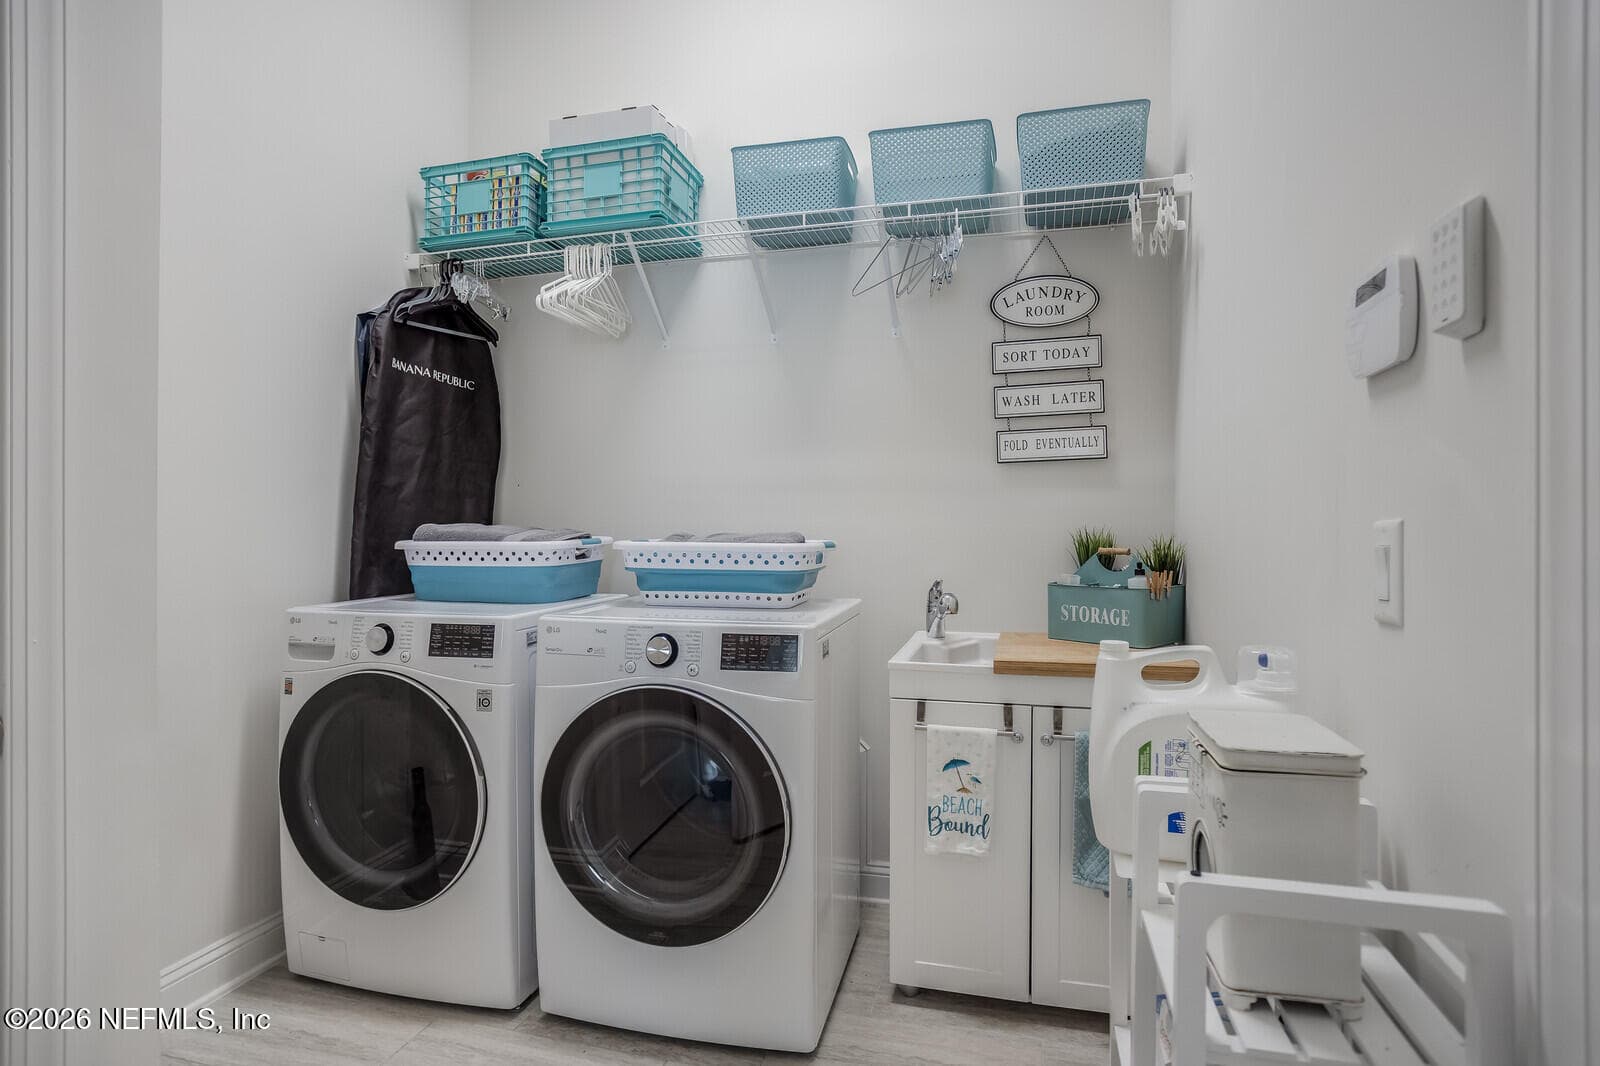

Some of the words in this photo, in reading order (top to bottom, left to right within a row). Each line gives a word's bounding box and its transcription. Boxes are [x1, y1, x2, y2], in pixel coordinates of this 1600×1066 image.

[1002, 285, 1088, 310] LAUNDRY
[1026, 304, 1065, 318] ROOM
[1002, 349, 1037, 363] SORT
[1043, 346, 1091, 361] TODAY
[391, 357, 431, 378] BANANA
[432, 369, 476, 391] REPUBLIC
[1001, 394, 1041, 408] WASH
[1052, 391, 1097, 405] LATER
[1003, 439, 1028, 452] FOLD
[1036, 435, 1100, 450] EVENTUALLY
[1060, 603, 1131, 627] STORAGE
[942, 794, 983, 817] BEACH
[927, 805, 991, 840] Bound
